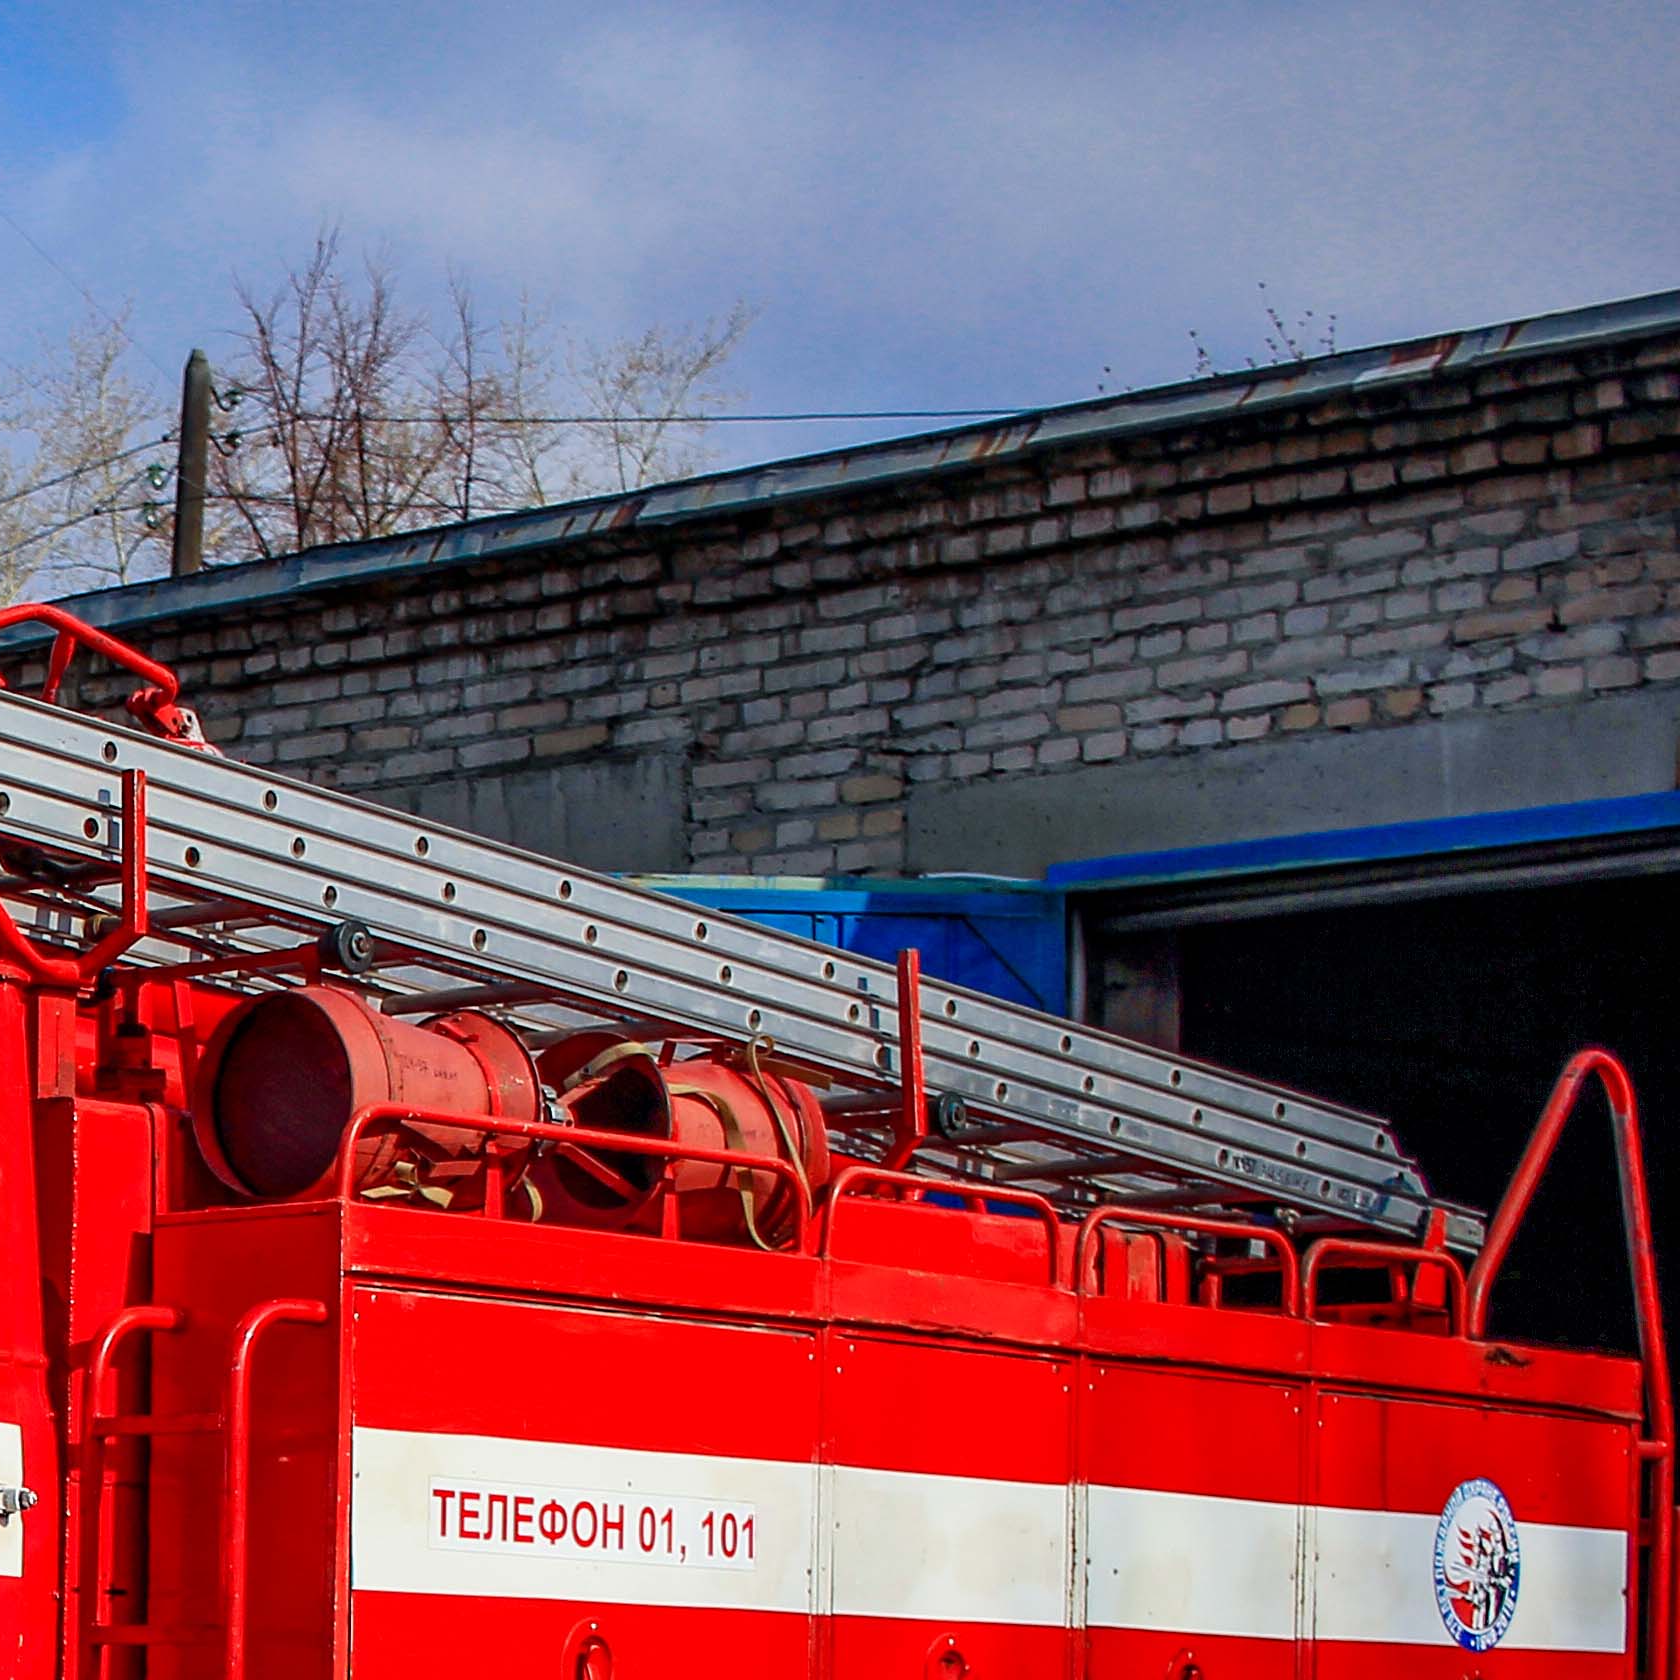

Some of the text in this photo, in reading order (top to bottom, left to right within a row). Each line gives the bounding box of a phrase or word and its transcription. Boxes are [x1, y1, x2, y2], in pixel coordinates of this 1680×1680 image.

[431, 1487, 755, 1565] ТЕЛЕФОН 01, 101
